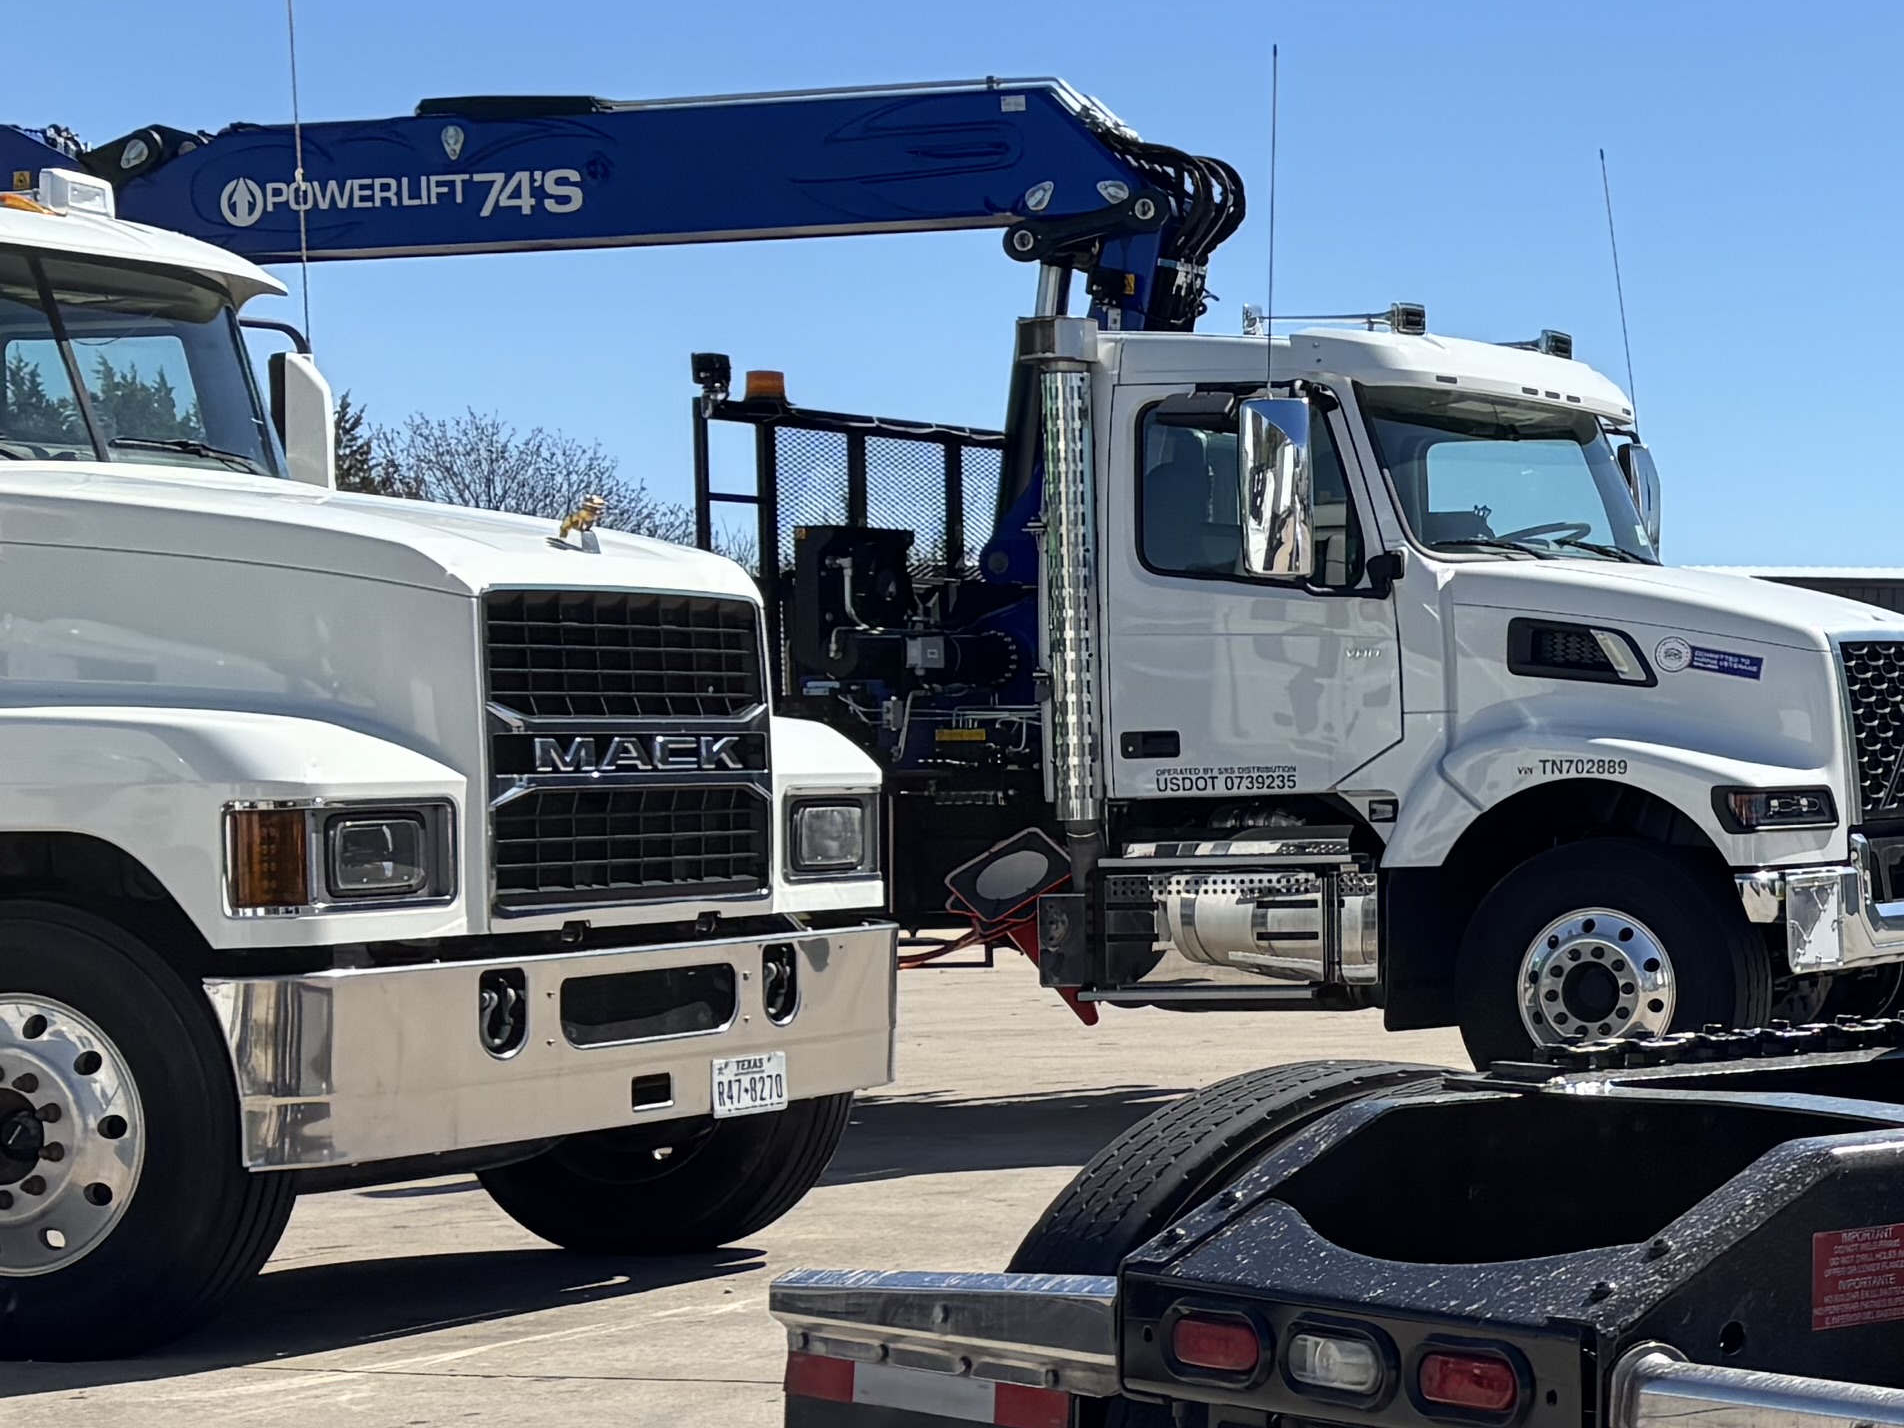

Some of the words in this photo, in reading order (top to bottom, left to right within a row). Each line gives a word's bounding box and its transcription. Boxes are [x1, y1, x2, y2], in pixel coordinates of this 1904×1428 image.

[266, 173, 470, 212] POWERLIFT
[534, 736, 743, 771] MACK
[1156, 767, 1201, 776] OPERATED
[1202, 767, 1214, 775] BY
[1538, 758, 1628, 776] TN702889
[1156, 776, 1219, 792] USDOT
[1224, 774, 1297, 791] 0739235
[735, 1057, 764, 1071] TEXAS
[1841, 1227, 1892, 1242] IMPORTANT
